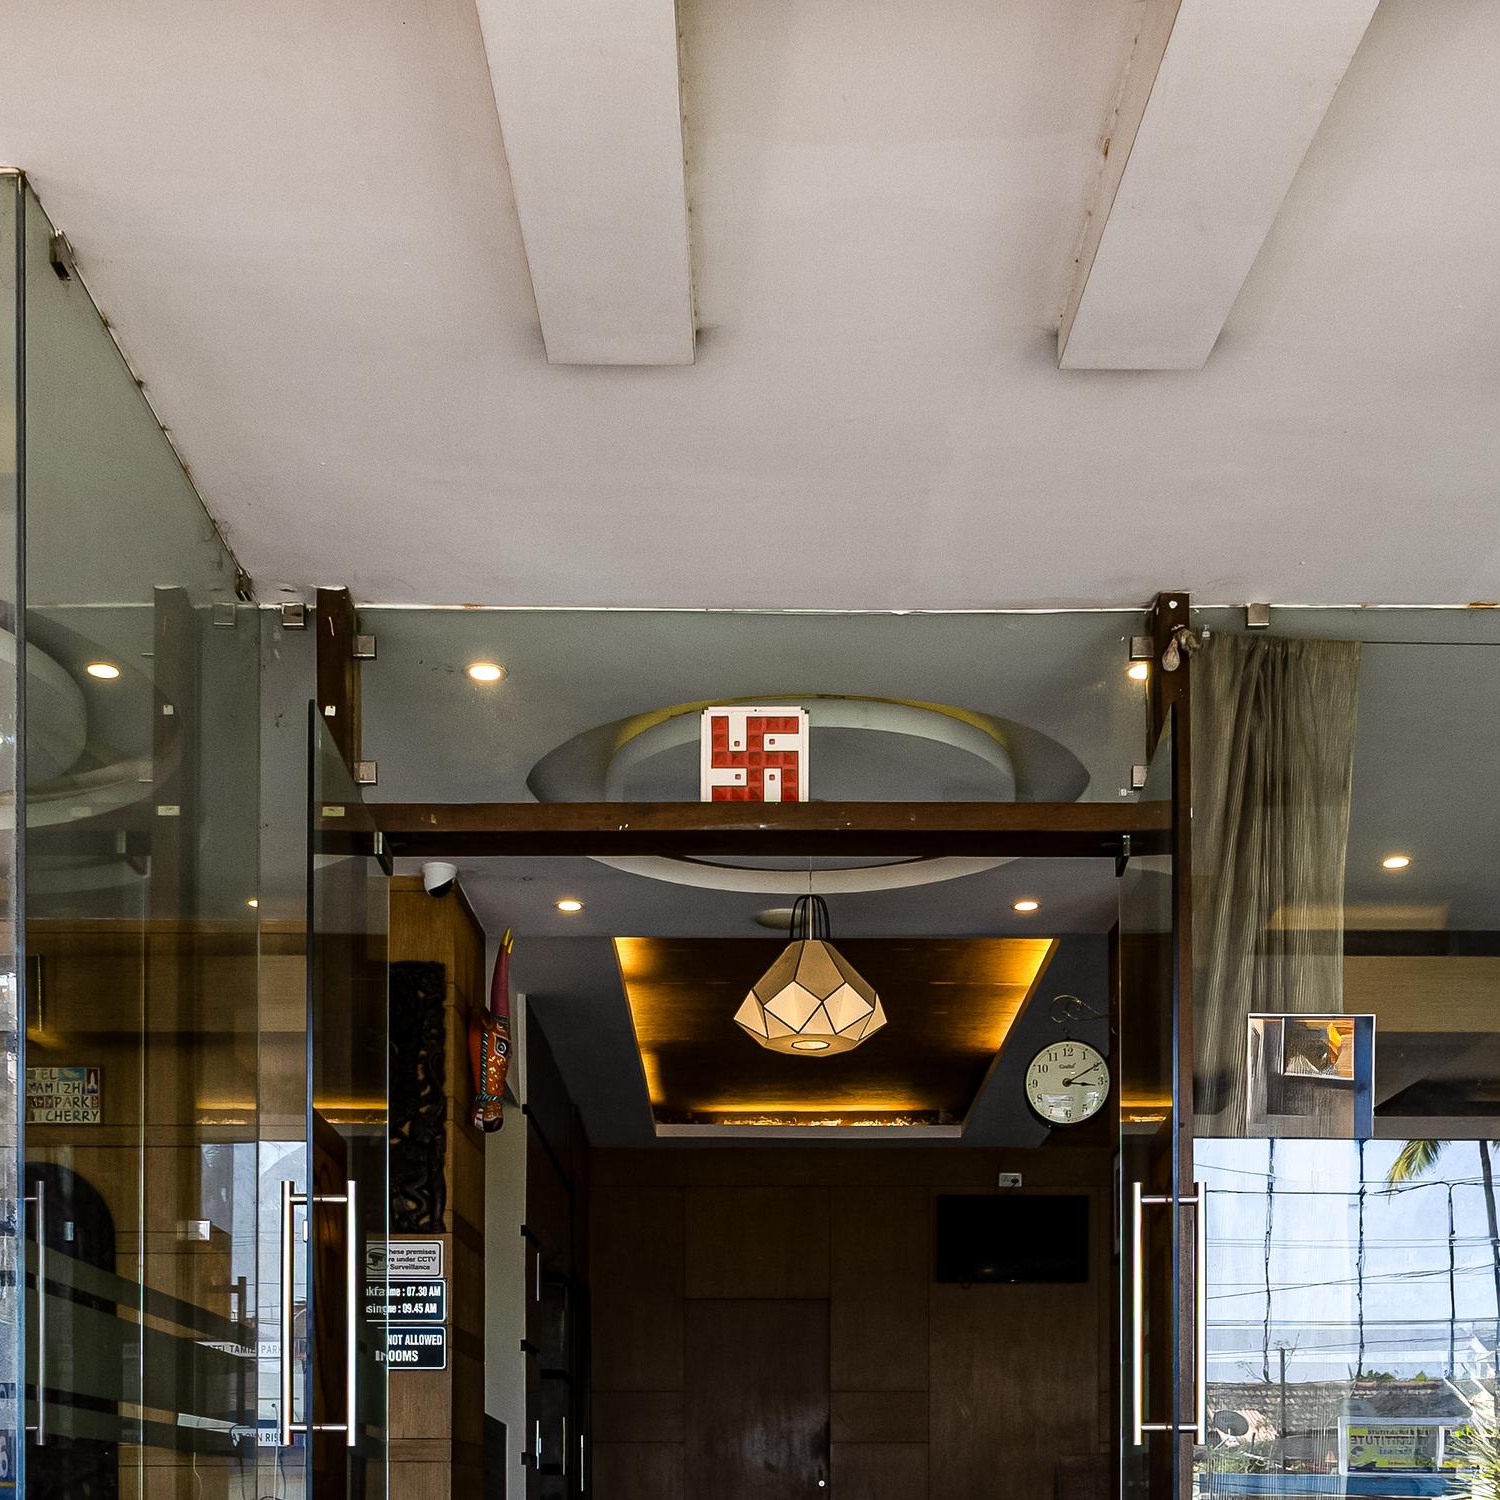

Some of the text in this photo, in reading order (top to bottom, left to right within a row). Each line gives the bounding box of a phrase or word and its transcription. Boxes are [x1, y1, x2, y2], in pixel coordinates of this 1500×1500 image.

[1048, 1053, 1058, 1061] 11
[1063, 1048, 1074, 1057] 12
[1038, 1064, 1048, 1073] 10
[54, 1097, 89, 1107] PARK
[44, 1110, 99, 1121] CHERRY
[406, 1286, 427, 1297] 07.30
[428, 1286, 441, 1296] AM
[402, 1303, 423, 1313] 09.45
[424, 1303, 437, 1313] AM
[388, 1334, 442, 1345] NOT ALLOWED
[261, 1345, 280, 1353] PAR
